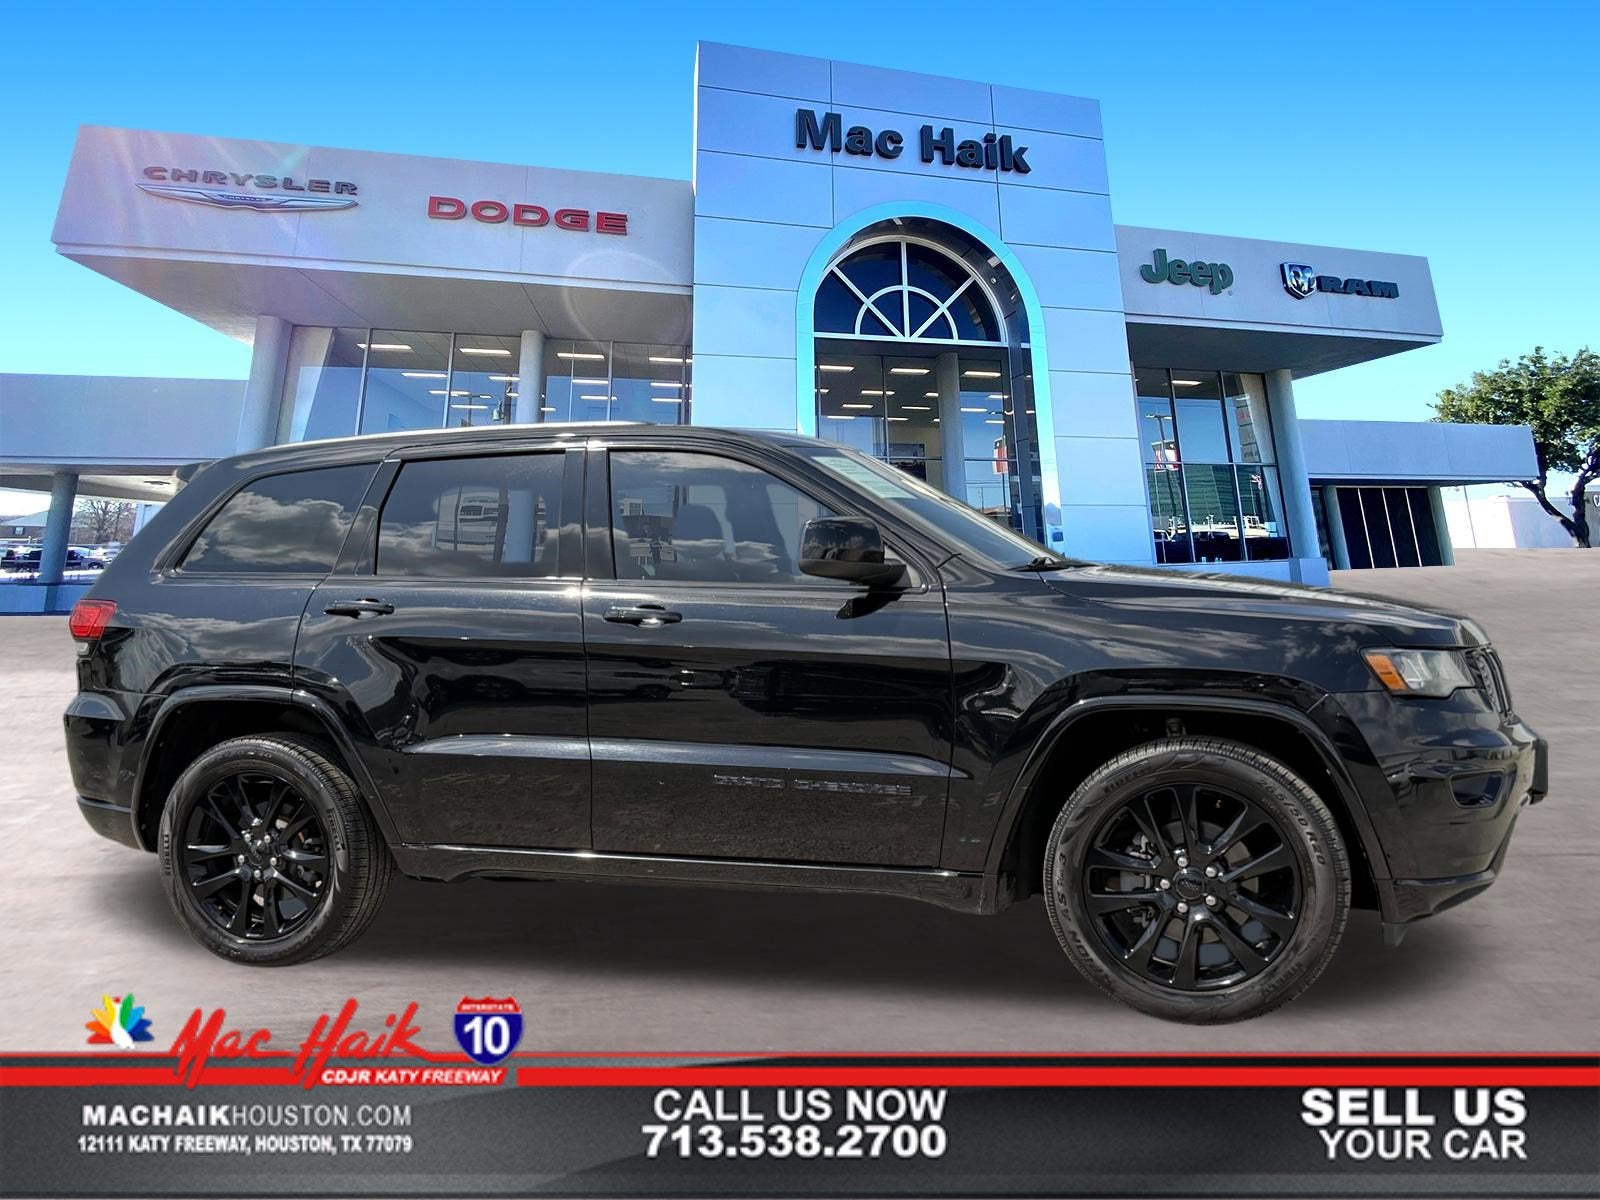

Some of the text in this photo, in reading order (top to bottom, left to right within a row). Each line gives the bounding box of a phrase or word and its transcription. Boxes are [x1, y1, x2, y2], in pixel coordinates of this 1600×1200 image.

[796, 108, 1032, 174] Mac Haik
[143, 166, 358, 196] CHRYSLER
[427, 195, 628, 236] DODGE
[1139, 248, 1234, 295] Jeep
[1315, 275, 1399, 299] RAM
